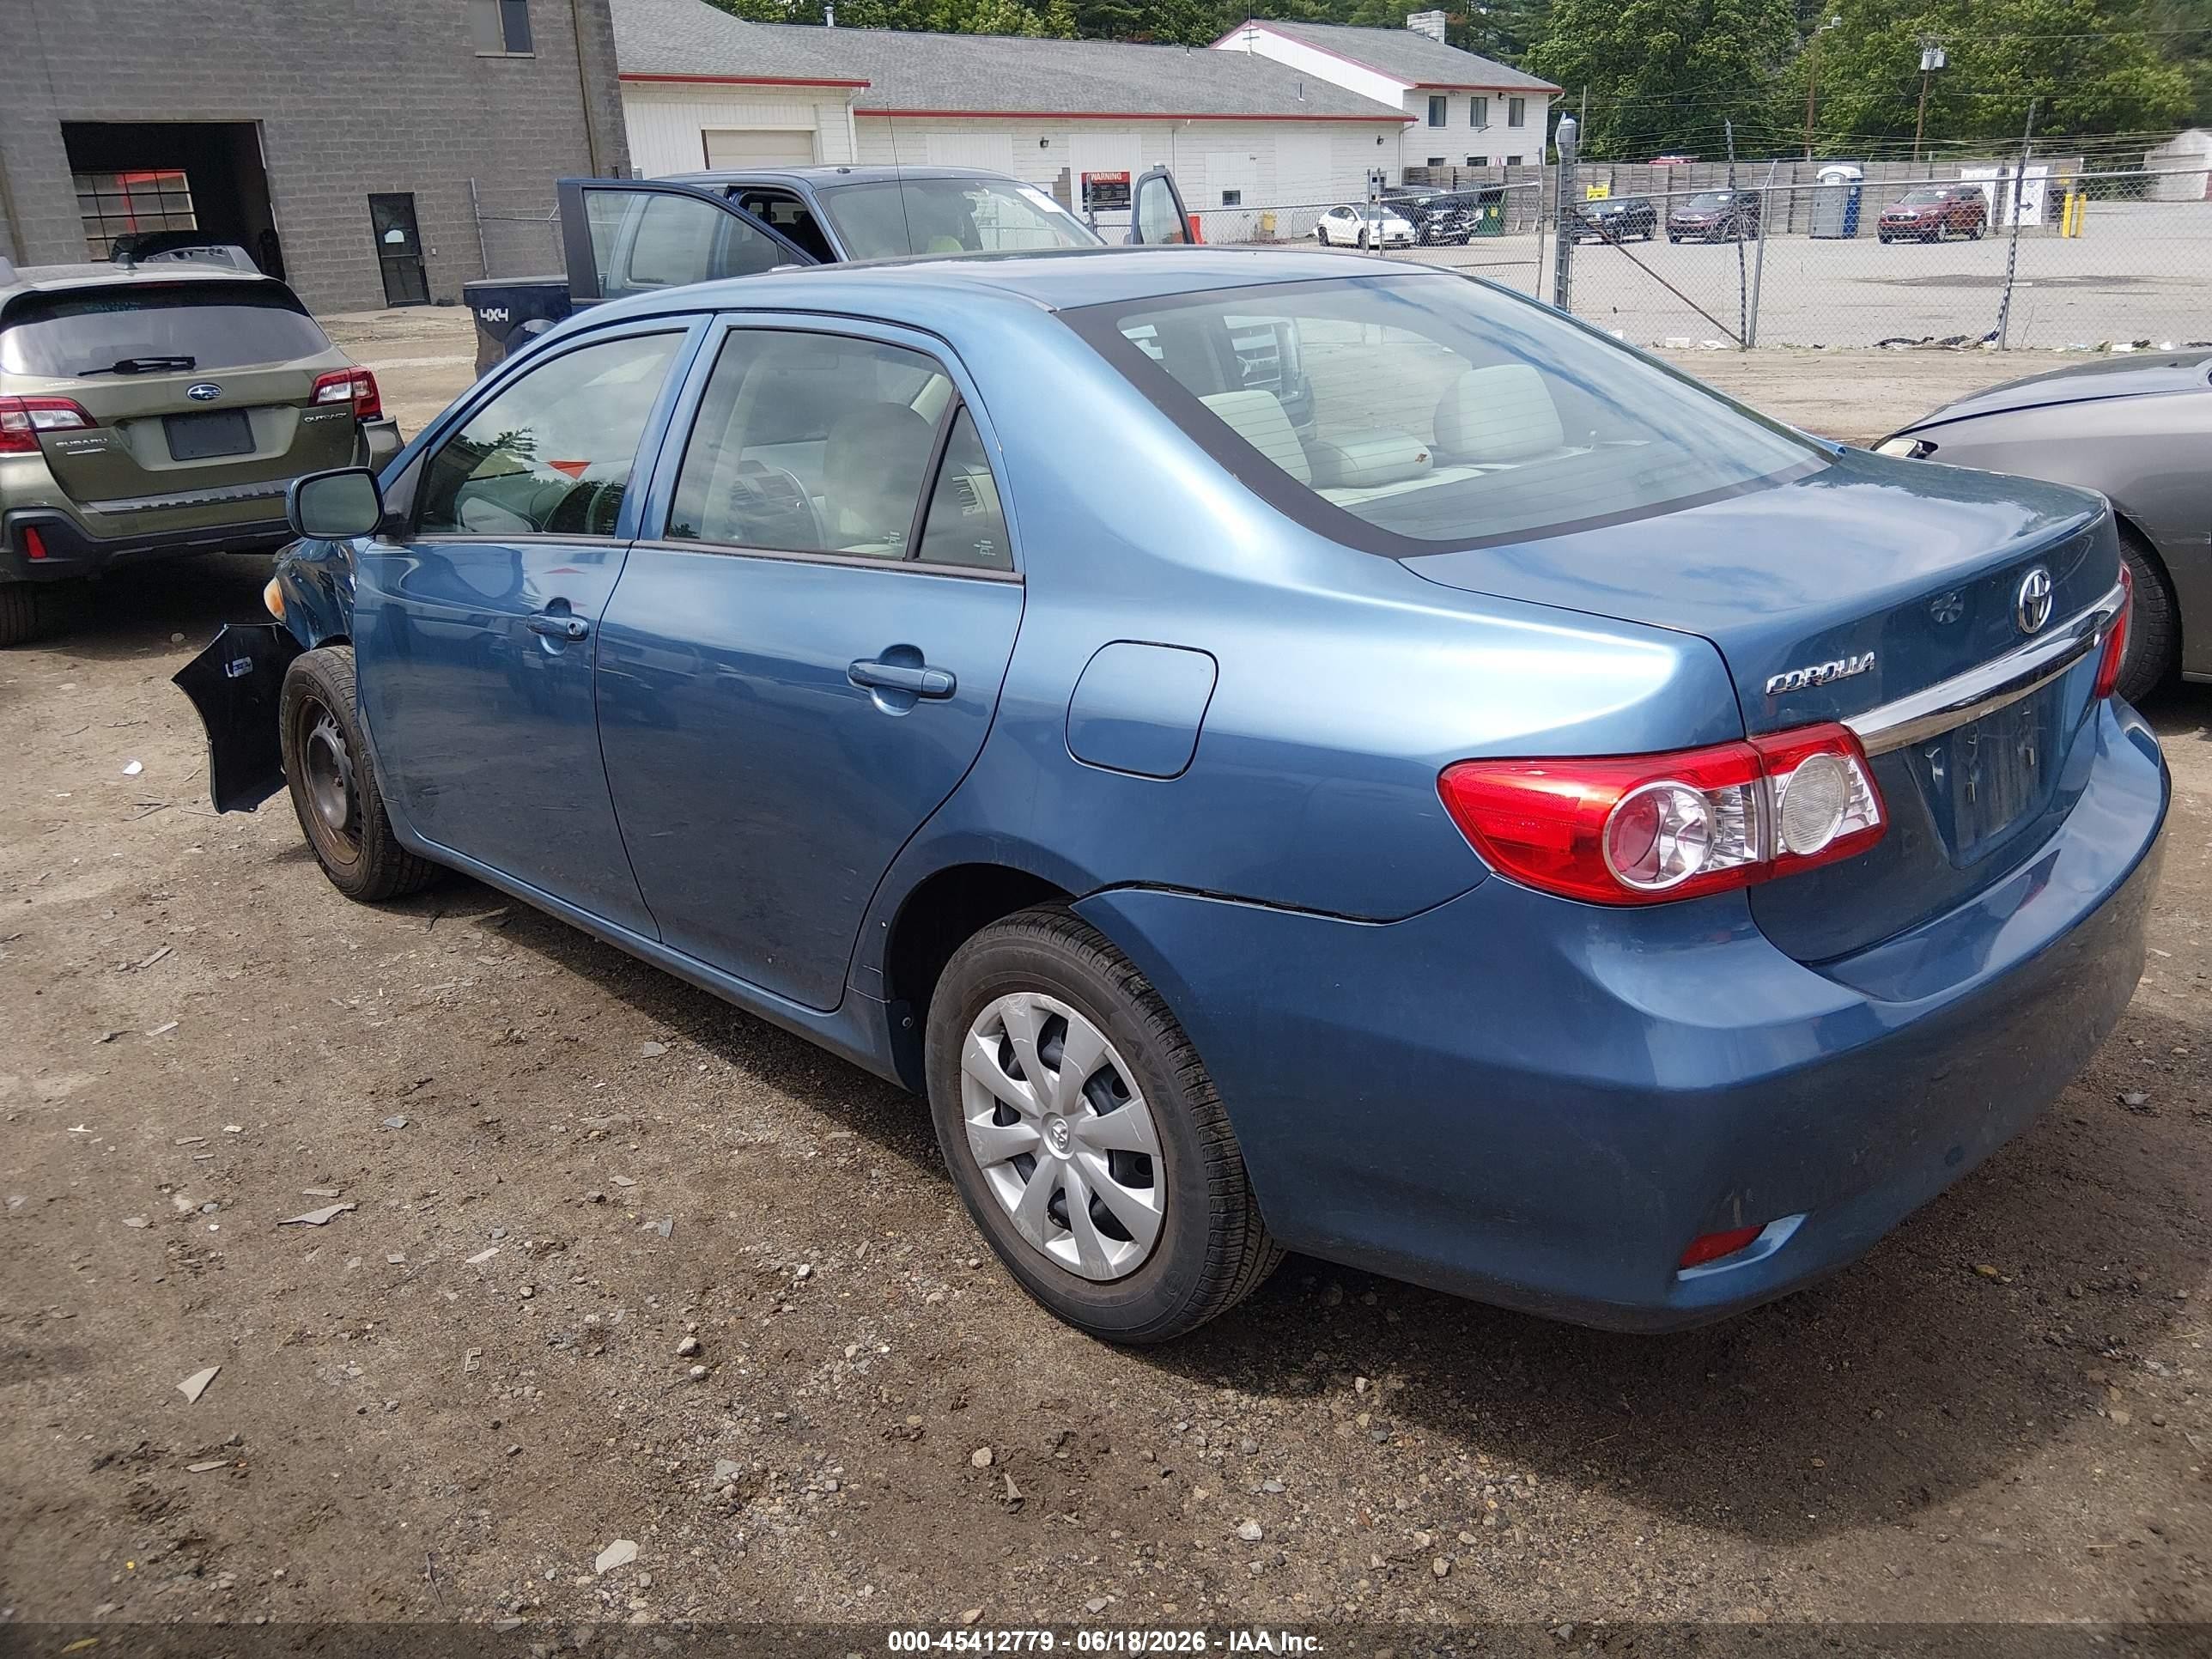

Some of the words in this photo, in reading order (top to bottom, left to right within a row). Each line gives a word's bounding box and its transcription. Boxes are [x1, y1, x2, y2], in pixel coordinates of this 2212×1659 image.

[1090, 172, 1122, 182] WARNING
[55, 437, 108, 447] SUBARU
[1765, 651, 1875, 696] COROLLA
